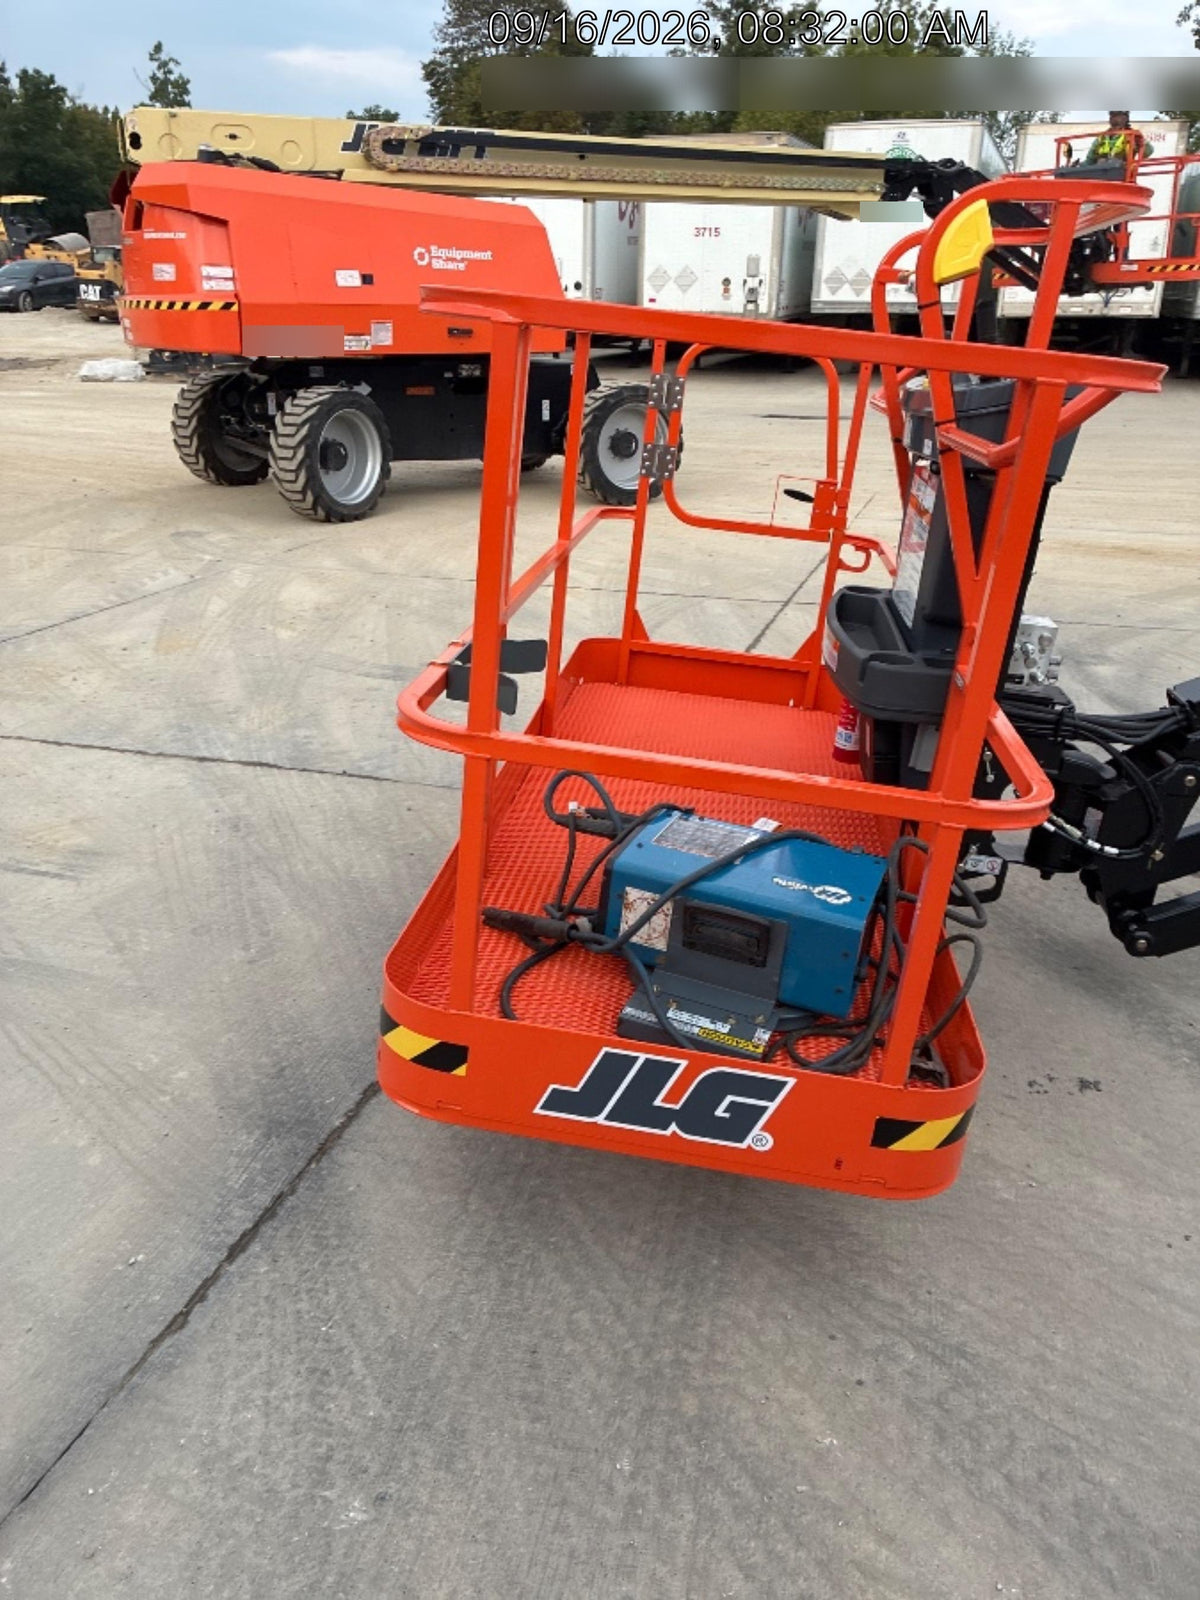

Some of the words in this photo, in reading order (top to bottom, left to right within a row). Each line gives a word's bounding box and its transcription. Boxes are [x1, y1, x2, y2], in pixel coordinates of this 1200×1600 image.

[694, 227, 721, 237] 3715
[430, 246, 493, 260] Equipment
[79, 284, 102, 301] CAT
